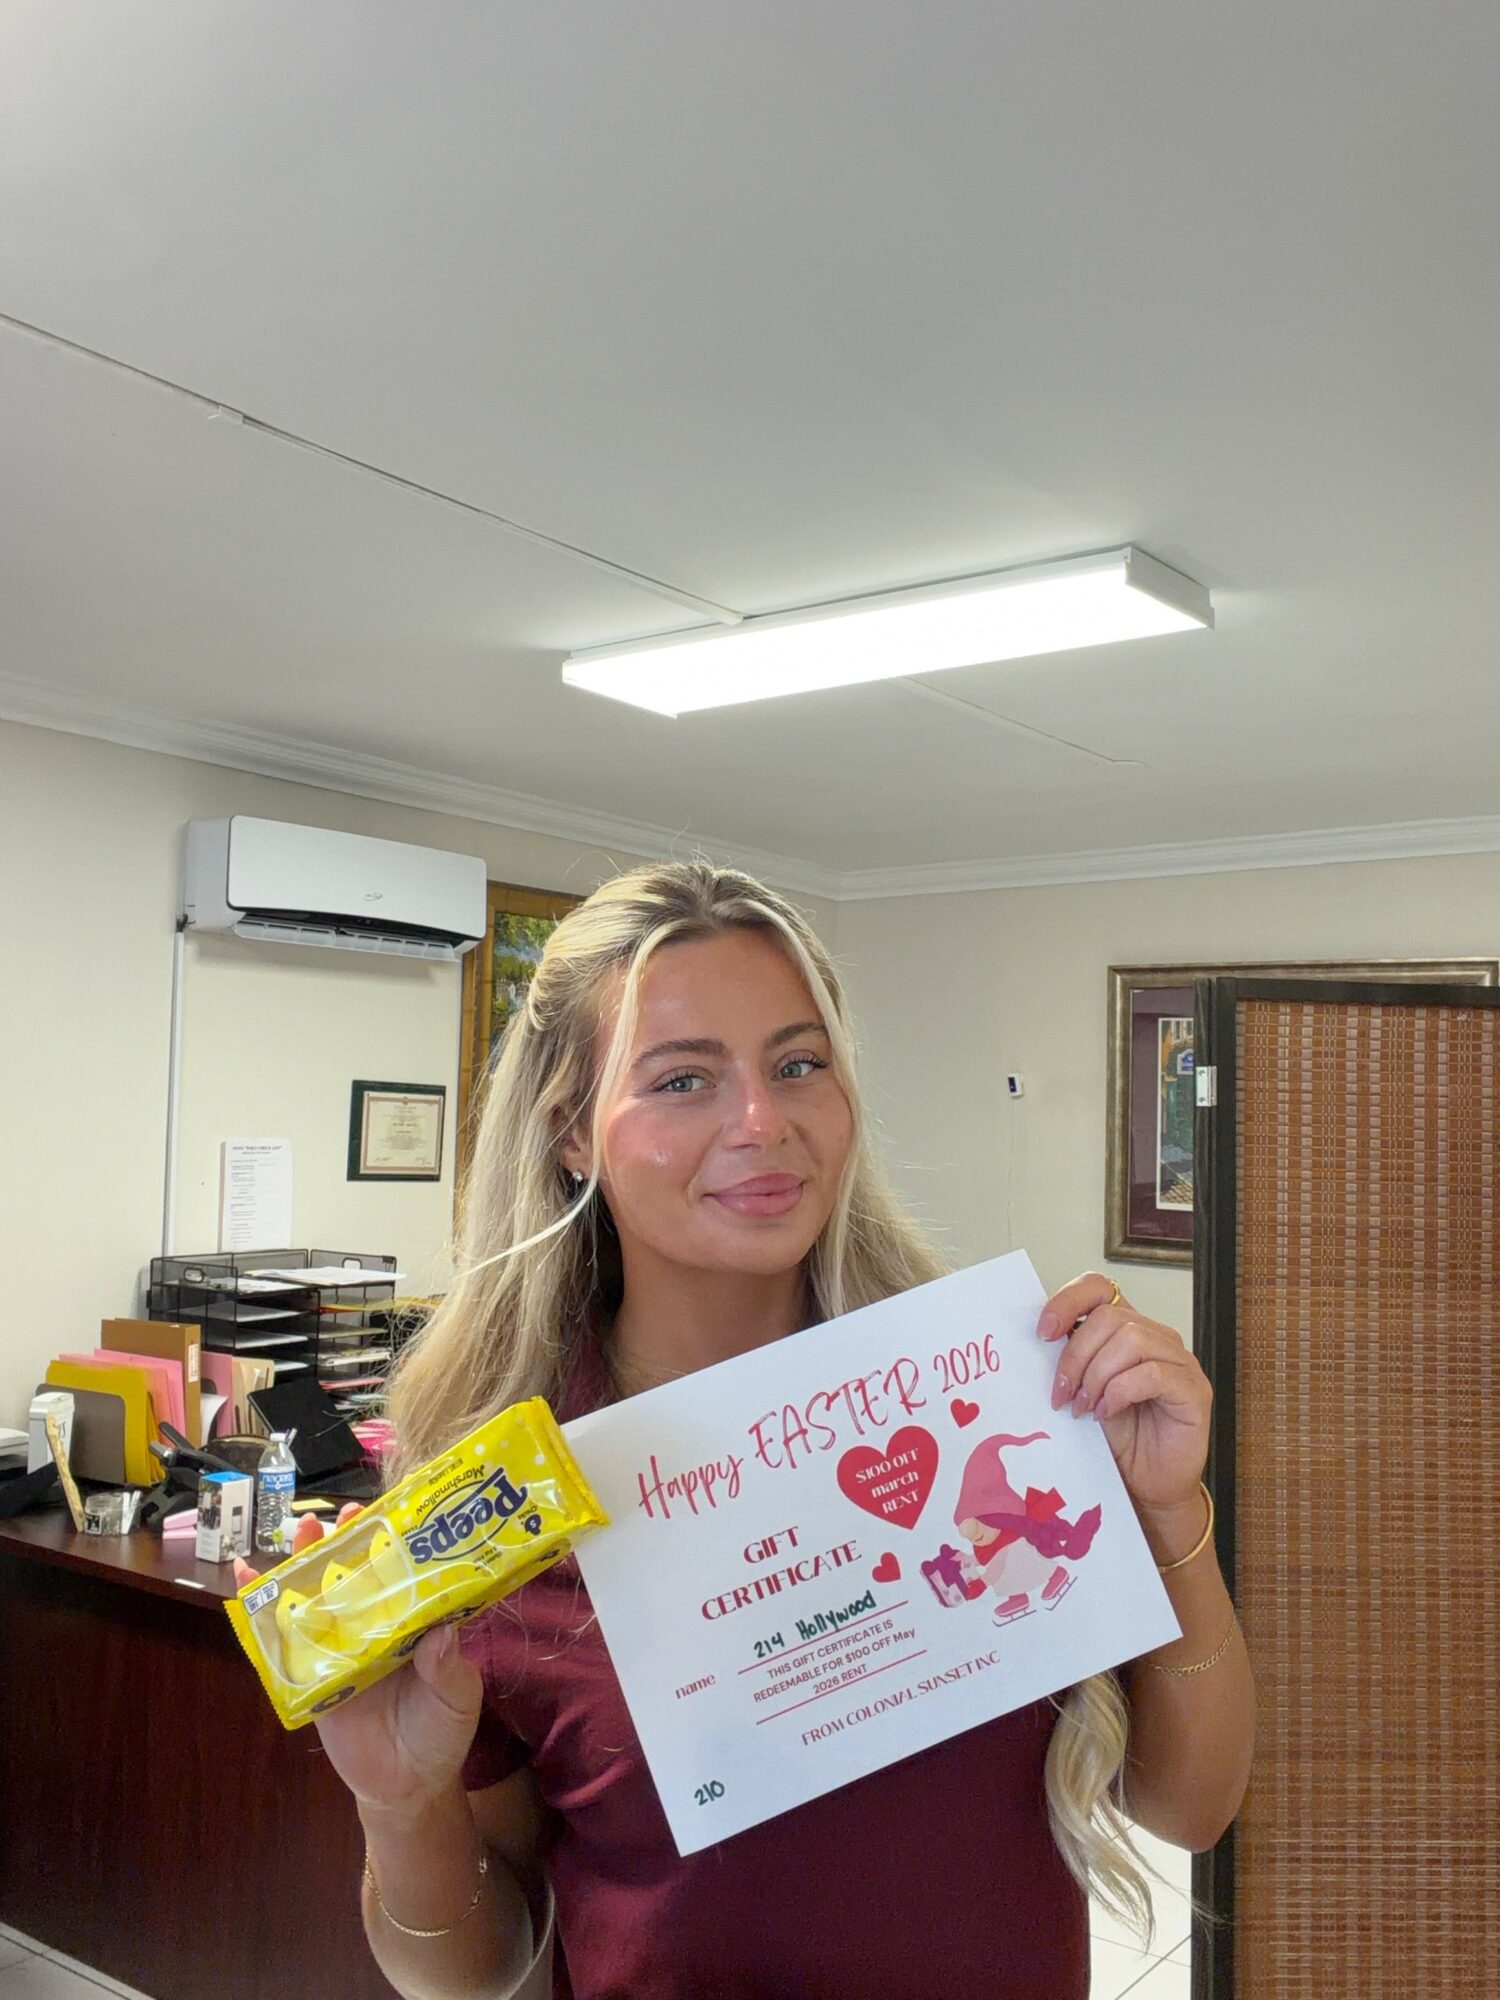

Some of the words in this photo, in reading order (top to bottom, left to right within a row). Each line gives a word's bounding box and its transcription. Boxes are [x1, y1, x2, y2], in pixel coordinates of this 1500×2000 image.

[639, 1454, 744, 1519] Happy
[748, 1357, 927, 1469] EASTER
[933, 1333, 1001, 1393] 2026
[892, 1447, 919, 1468] OFF
[416, 1464, 485, 1517] Marshmallow
[871, 1471, 920, 1499] march
[882, 1489, 919, 1514] RENT
[408, 1475, 528, 1564] Peeps
[743, 1526, 799, 1564] GIFT
[701, 1540, 862, 1621] CERTIFICATE
[753, 1631, 785, 1659] 214
[795, 1589, 877, 1641] Hollywood
[767, 1663, 792, 1680] THIS
[792, 1652, 816, 1670] GIFT
[817, 1624, 882, 1659] CERTIFICATE
[883, 1619, 894, 1631] IS
[675, 1674, 717, 1699] name
[753, 1665, 822, 1703] REDEEMABLE
[822, 1656, 845, 1674] FOR
[845, 1646, 871, 1664] $100
[871, 1637, 892, 1652] OFF
[894, 1628, 916, 1644] May
[812, 1677, 841, 1695] 2026
[841, 1663, 868, 1682] RENT
[801, 1717, 846, 1746] FROM
[846, 1687, 918, 1727] COLONIAL
[916, 1660, 976, 1696] SUNSET
[975, 1649, 1001, 1672] INC
[694, 1779, 726, 1806] 210
